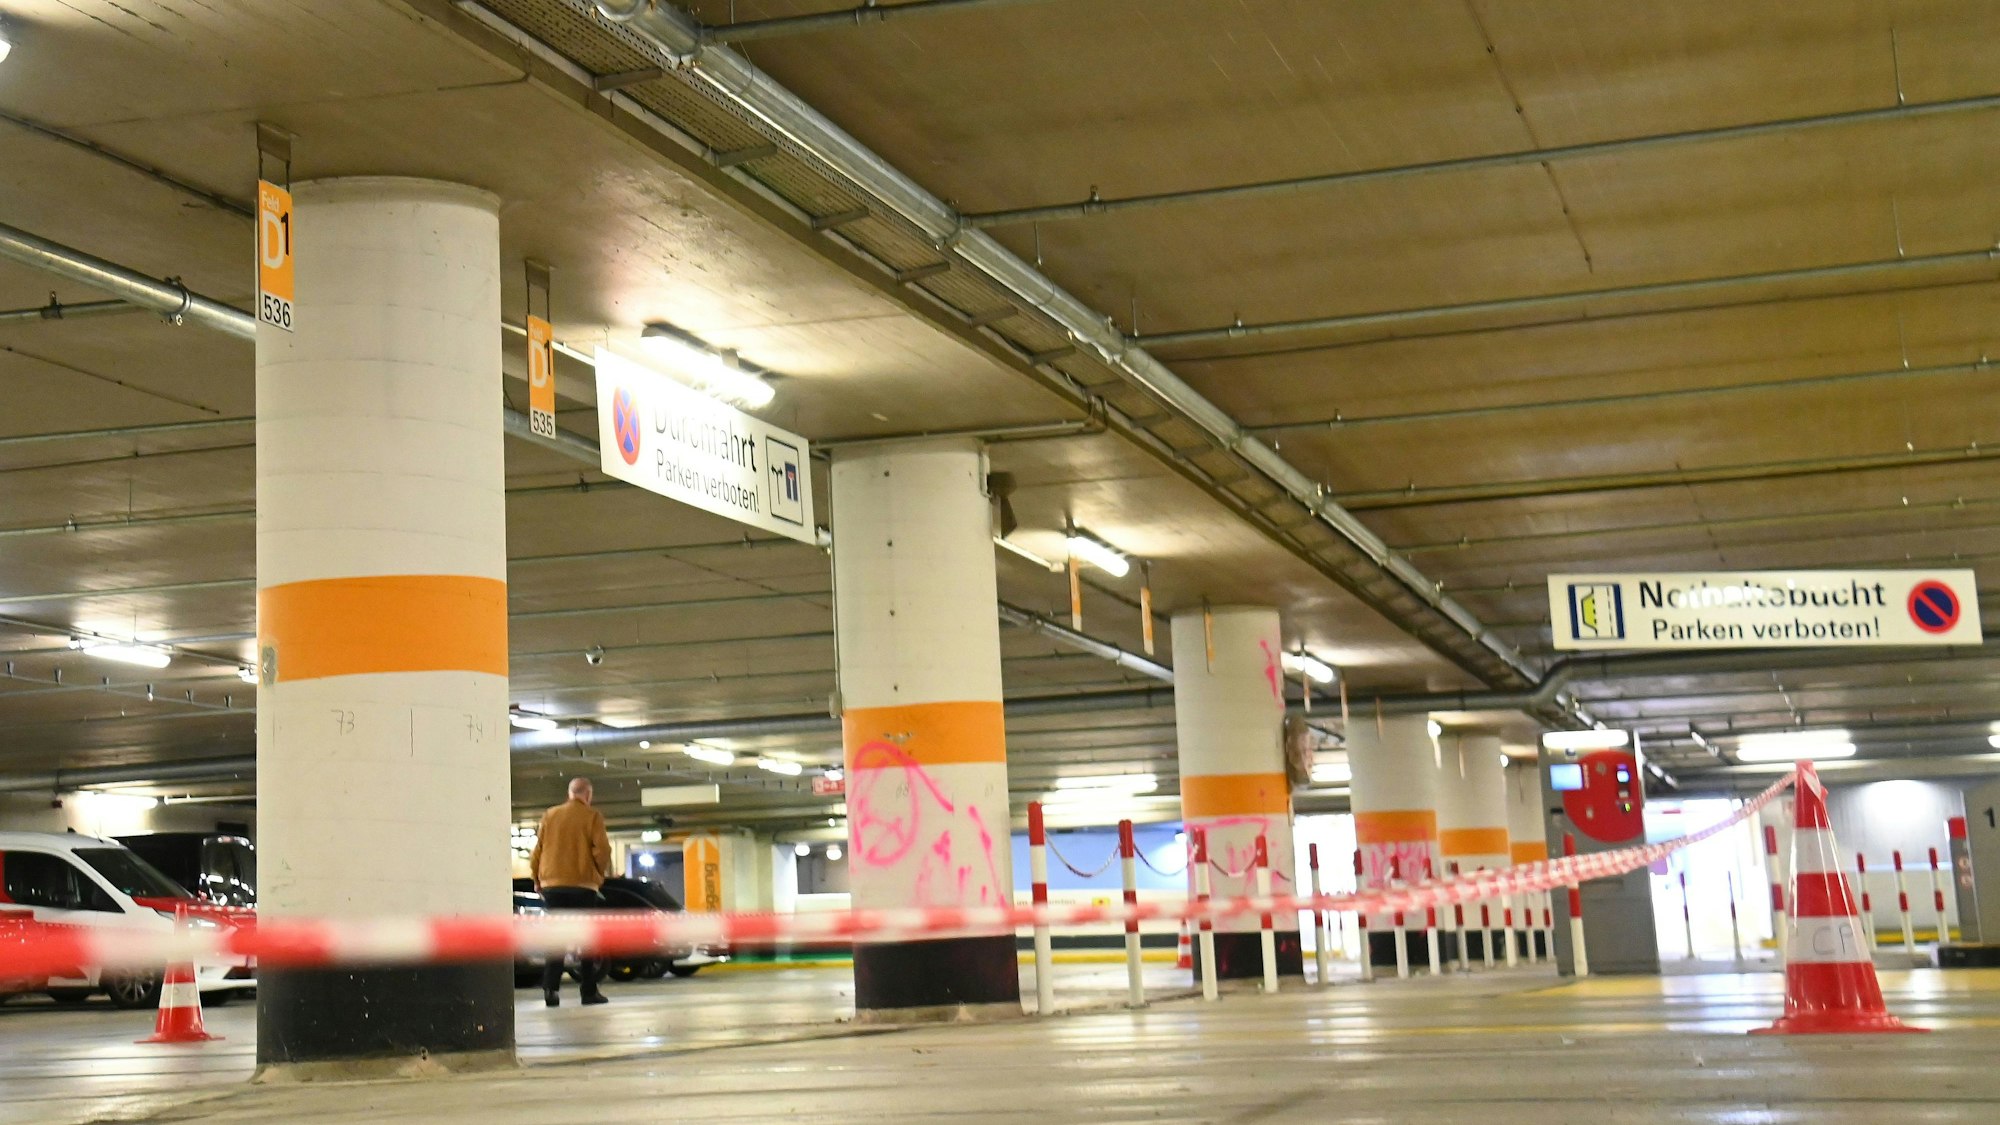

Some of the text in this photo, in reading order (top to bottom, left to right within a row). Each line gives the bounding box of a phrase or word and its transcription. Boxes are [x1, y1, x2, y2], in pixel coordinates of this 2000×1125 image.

[262, 190, 280, 212] Feld
[264, 294, 291, 328] 536
[532, 410, 553, 436] 535
[656, 448, 760, 514] Parken verboten!
[1652, 616, 1881, 641] Parken verboten!
[331, 709, 355, 736] 73
[1982, 806, 1996, 829] 1
